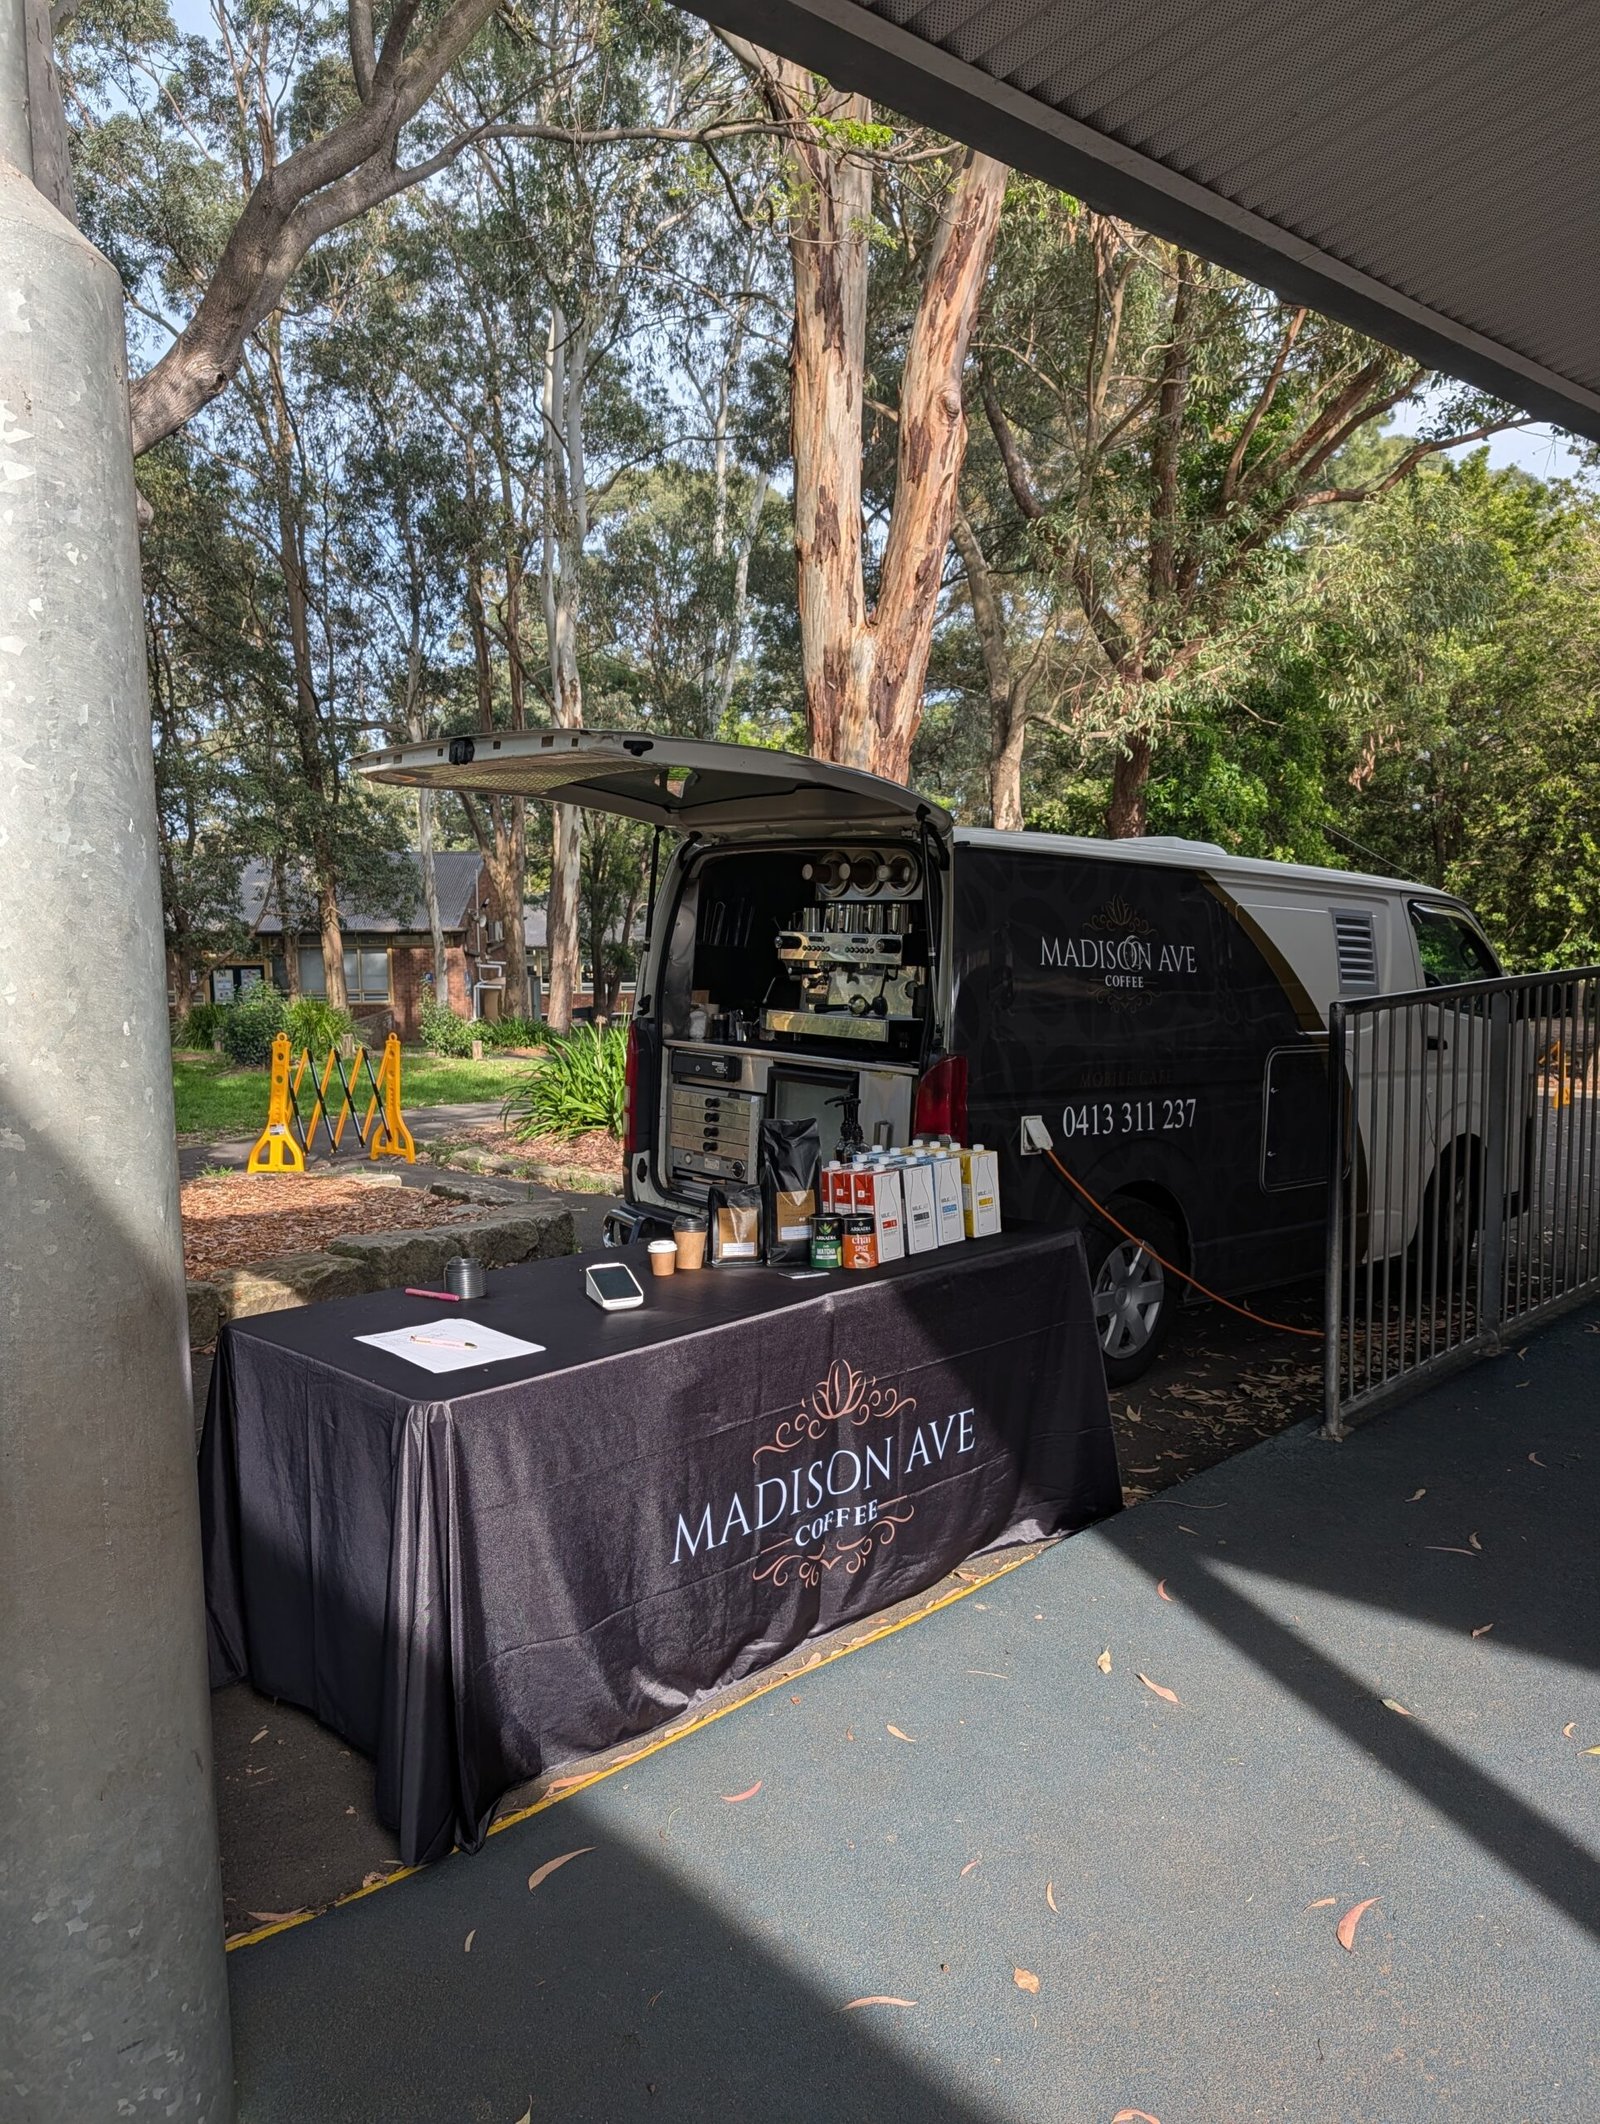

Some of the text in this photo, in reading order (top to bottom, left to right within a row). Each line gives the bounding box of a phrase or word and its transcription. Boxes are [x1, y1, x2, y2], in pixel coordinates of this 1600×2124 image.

[1039, 935, 1198, 973] MADISON AVE
[1105, 974, 1144, 988] COFFEE
[1062, 1098, 1197, 1138] 0413 311 237
[670, 1407, 976, 1565] MADISON AVE
[795, 1499, 878, 1547] COFFEE
